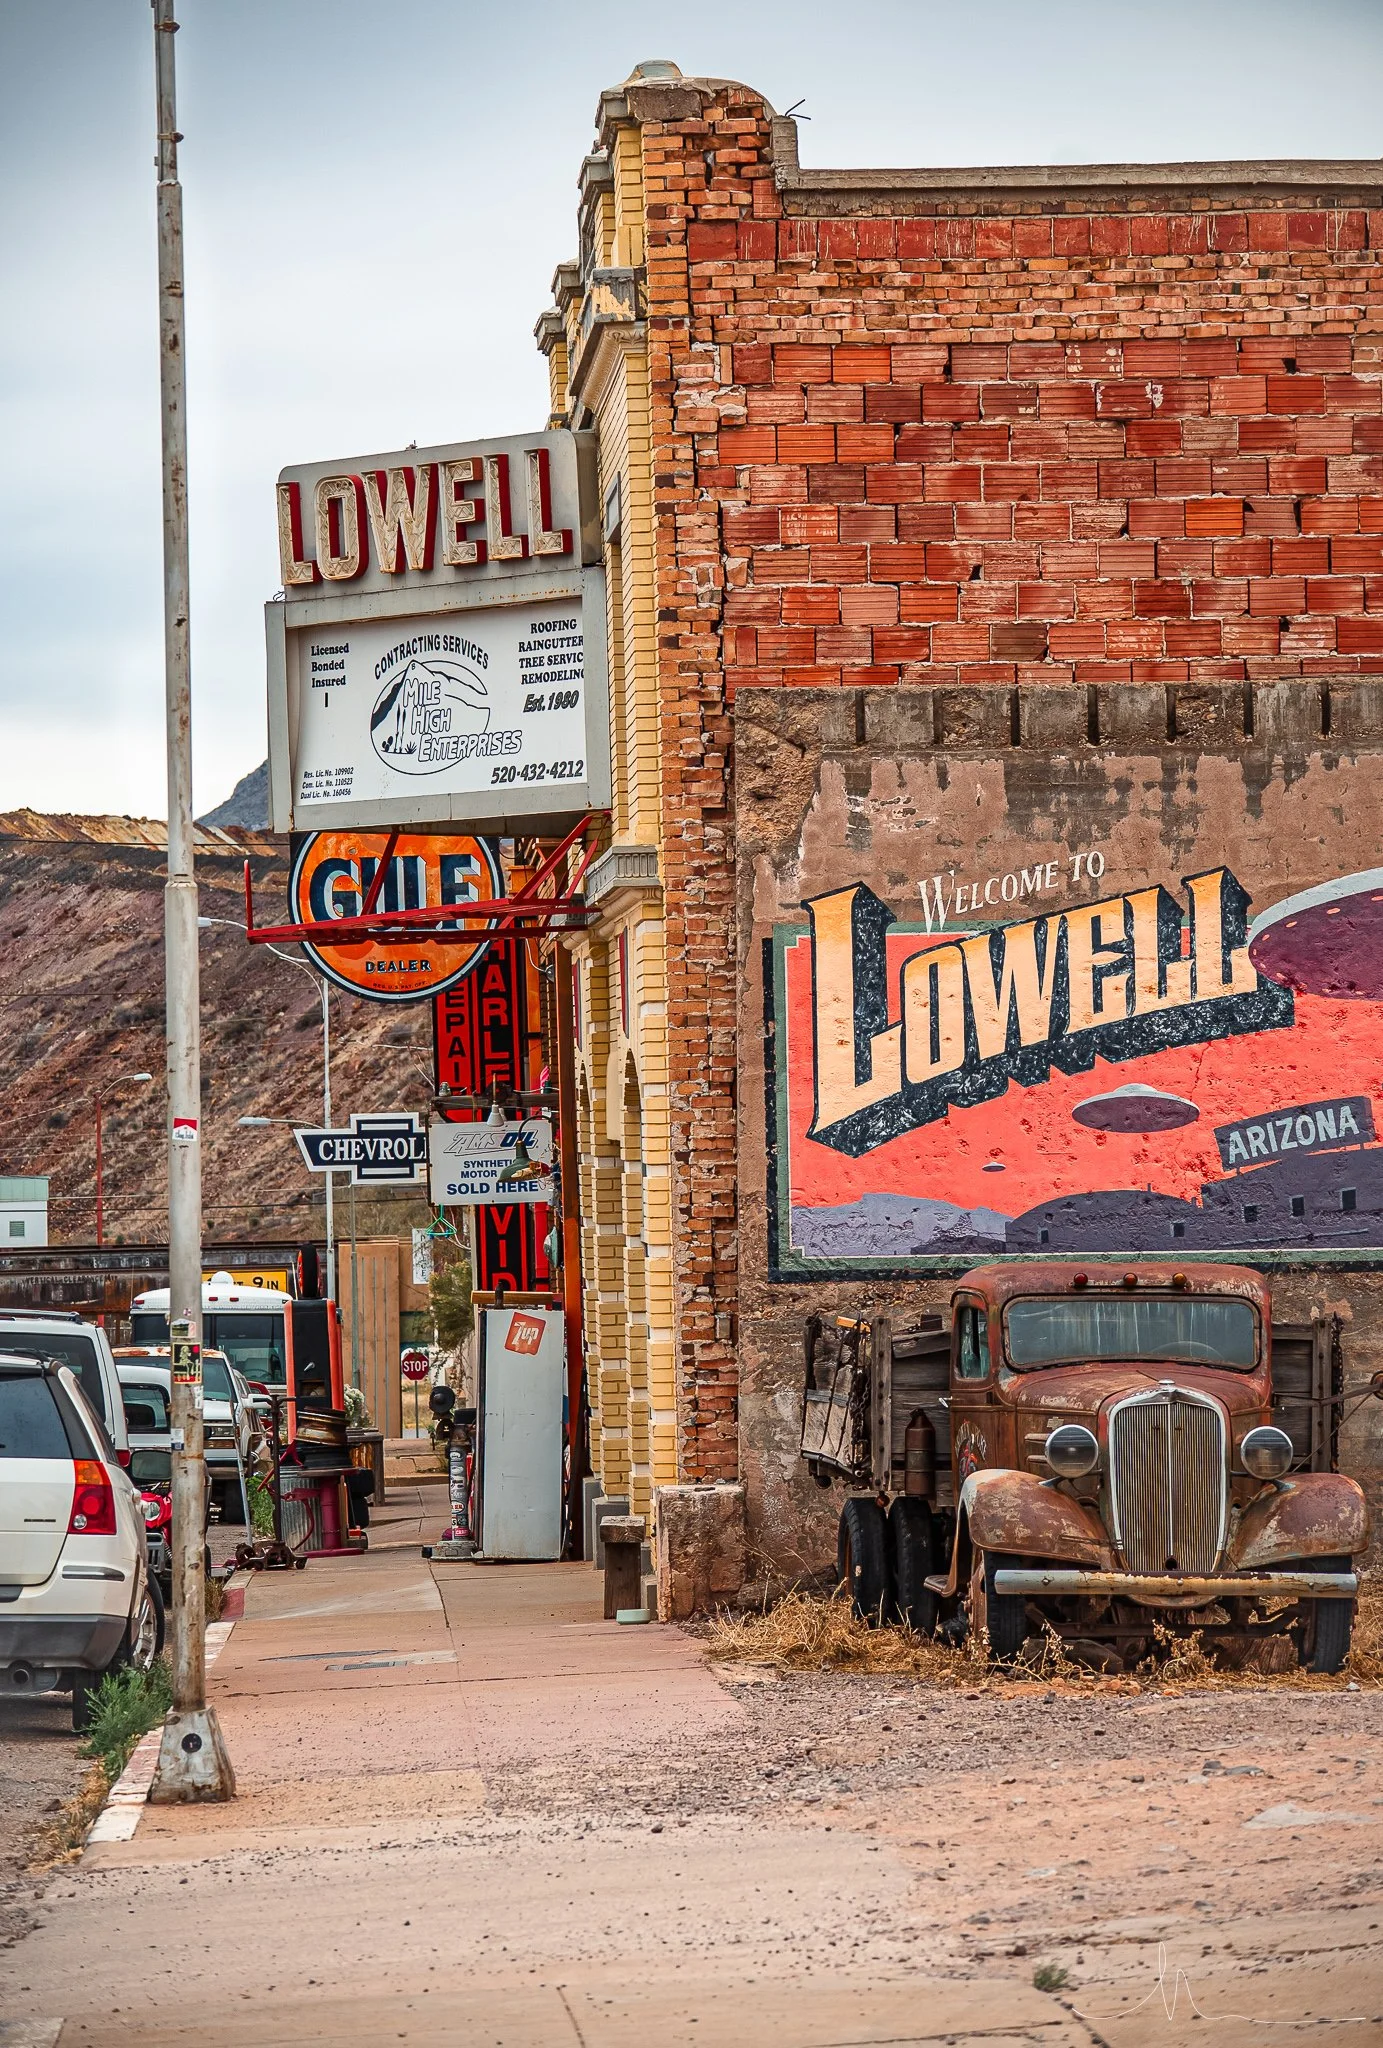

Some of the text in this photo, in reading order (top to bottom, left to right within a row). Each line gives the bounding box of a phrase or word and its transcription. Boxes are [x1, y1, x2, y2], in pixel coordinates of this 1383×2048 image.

[276, 448, 573, 585] LOWELL
[530, 619, 577, 634] ROOFING
[311, 642, 350, 656] Licensed
[518, 635, 584, 652] RAINGUTTER
[311, 659, 345, 672] Bonded
[374, 634, 489, 680] CONTRACTING SERVICES
[518, 656, 545, 668] TREE
[311, 675, 346, 688] Insured
[403, 678, 441, 708] MILE
[523, 690, 580, 713] Est. 1980
[411, 706, 451, 735] HIGH
[418, 730, 522, 762] ENTERPRISES
[309, 853, 481, 931] GULF
[917, 850, 1106, 937] WELCOME TO
[365, 959, 432, 974] DEALER
[802, 866, 1280, 1150] LOWELL
[443, 1131, 539, 1156] AMSOIL
[1228, 1105, 1360, 1164] ARIZONA
[318, 1136, 427, 1161] CHEVROL
[460, 1169, 498, 1179] MOTOR
[446, 1180, 539, 1195] SOLD HERE
[403, 1360, 428, 1372] STOP
